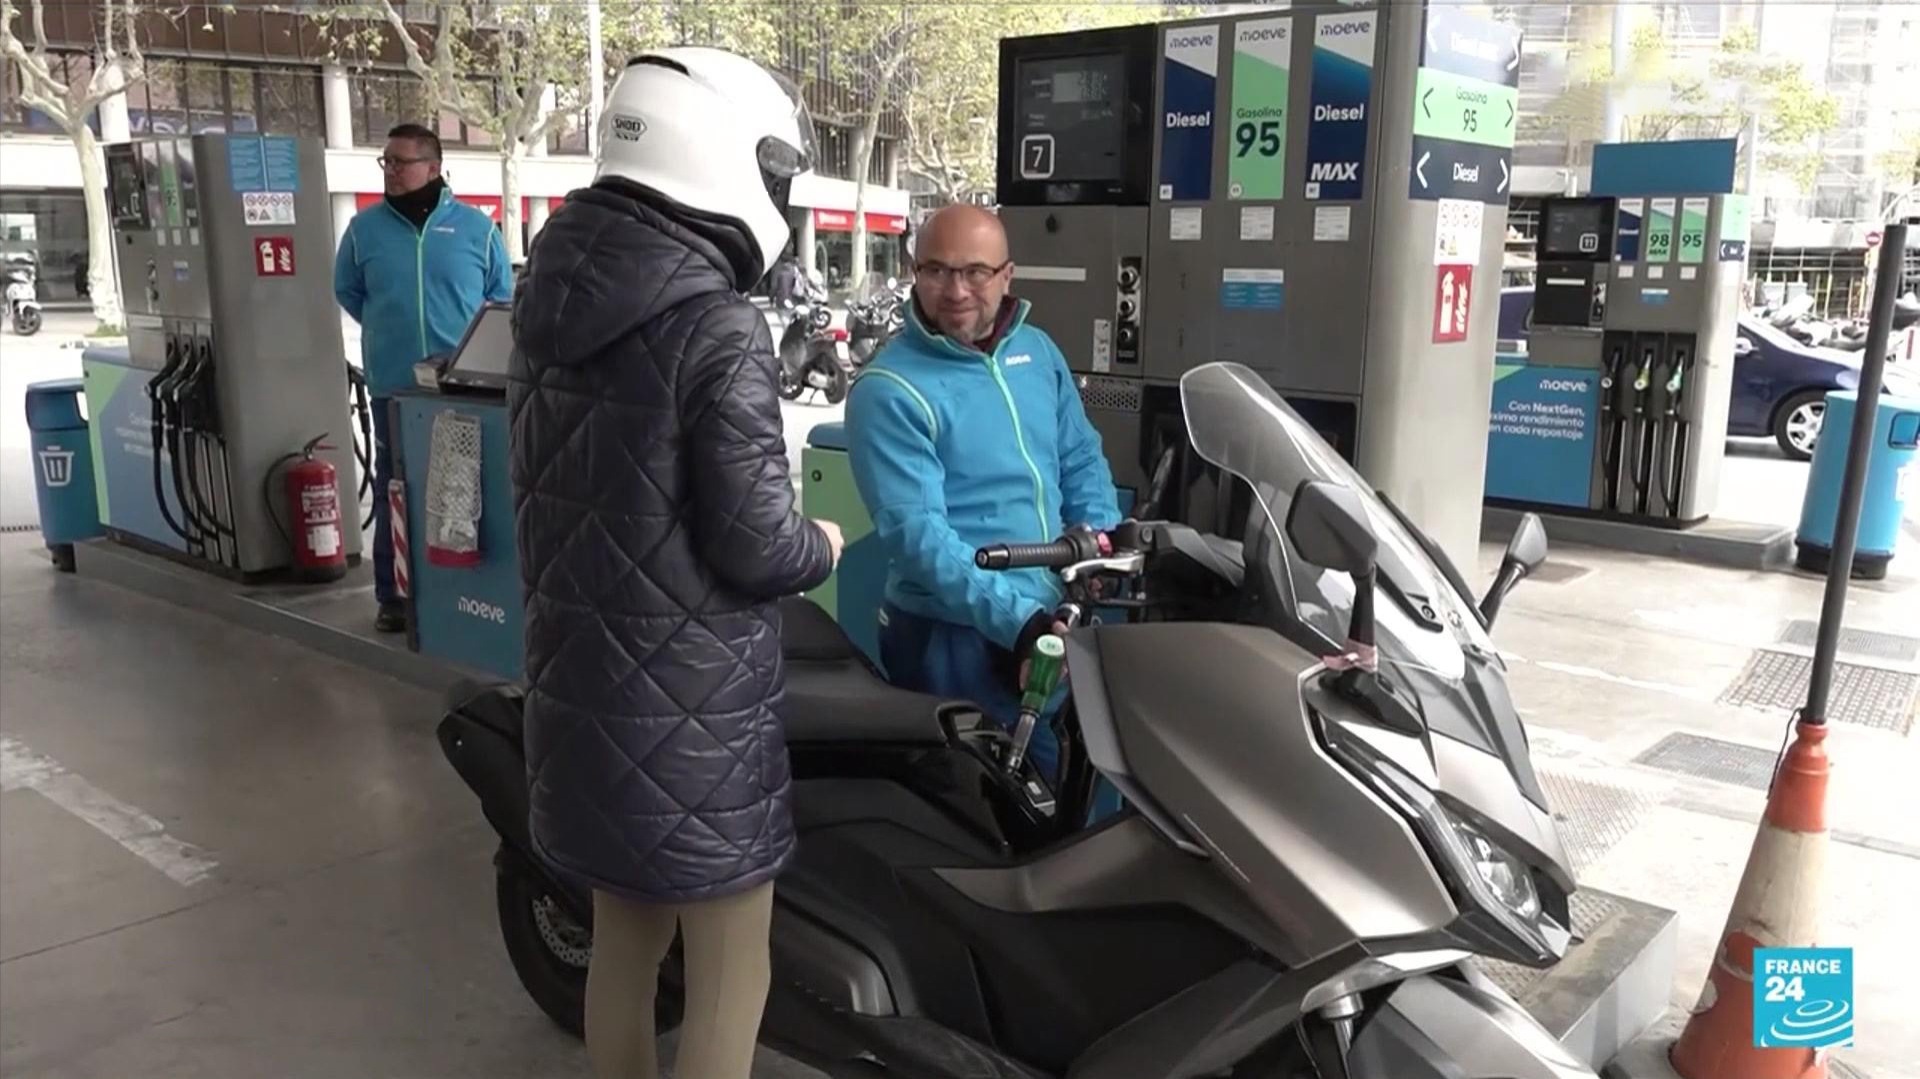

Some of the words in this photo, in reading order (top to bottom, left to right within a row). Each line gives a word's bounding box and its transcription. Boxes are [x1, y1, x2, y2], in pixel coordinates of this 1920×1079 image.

[1239, 27, 1286, 42] moeve
[1320, 21, 1370, 36] moeve
[1169, 34, 1214, 49] moeve
[1166, 111, 1210, 128] Diesel
[1236, 106, 1282, 119] Gasolina
[1314, 103, 1364, 121] Diesel
[1463, 108, 1477, 132] 95
[1236, 121, 1280, 158] 95
[1031, 146, 1044, 168] 7
[1310, 162, 1359, 181] MAX
[1453, 162, 1479, 182] Diesel
[1649, 233, 1670, 247] 98
[1681, 233, 1703, 248] 95
[1539, 379, 1588, 393] moeve
[1508, 400, 1531, 412] Con
[1532, 402, 1585, 417] NextGen,
[1519, 414, 1585, 428] rendimiento
[1503, 424, 1530, 435] cada
[1532, 428, 1584, 441] repostaje
[457, 596, 506, 624] moeve
